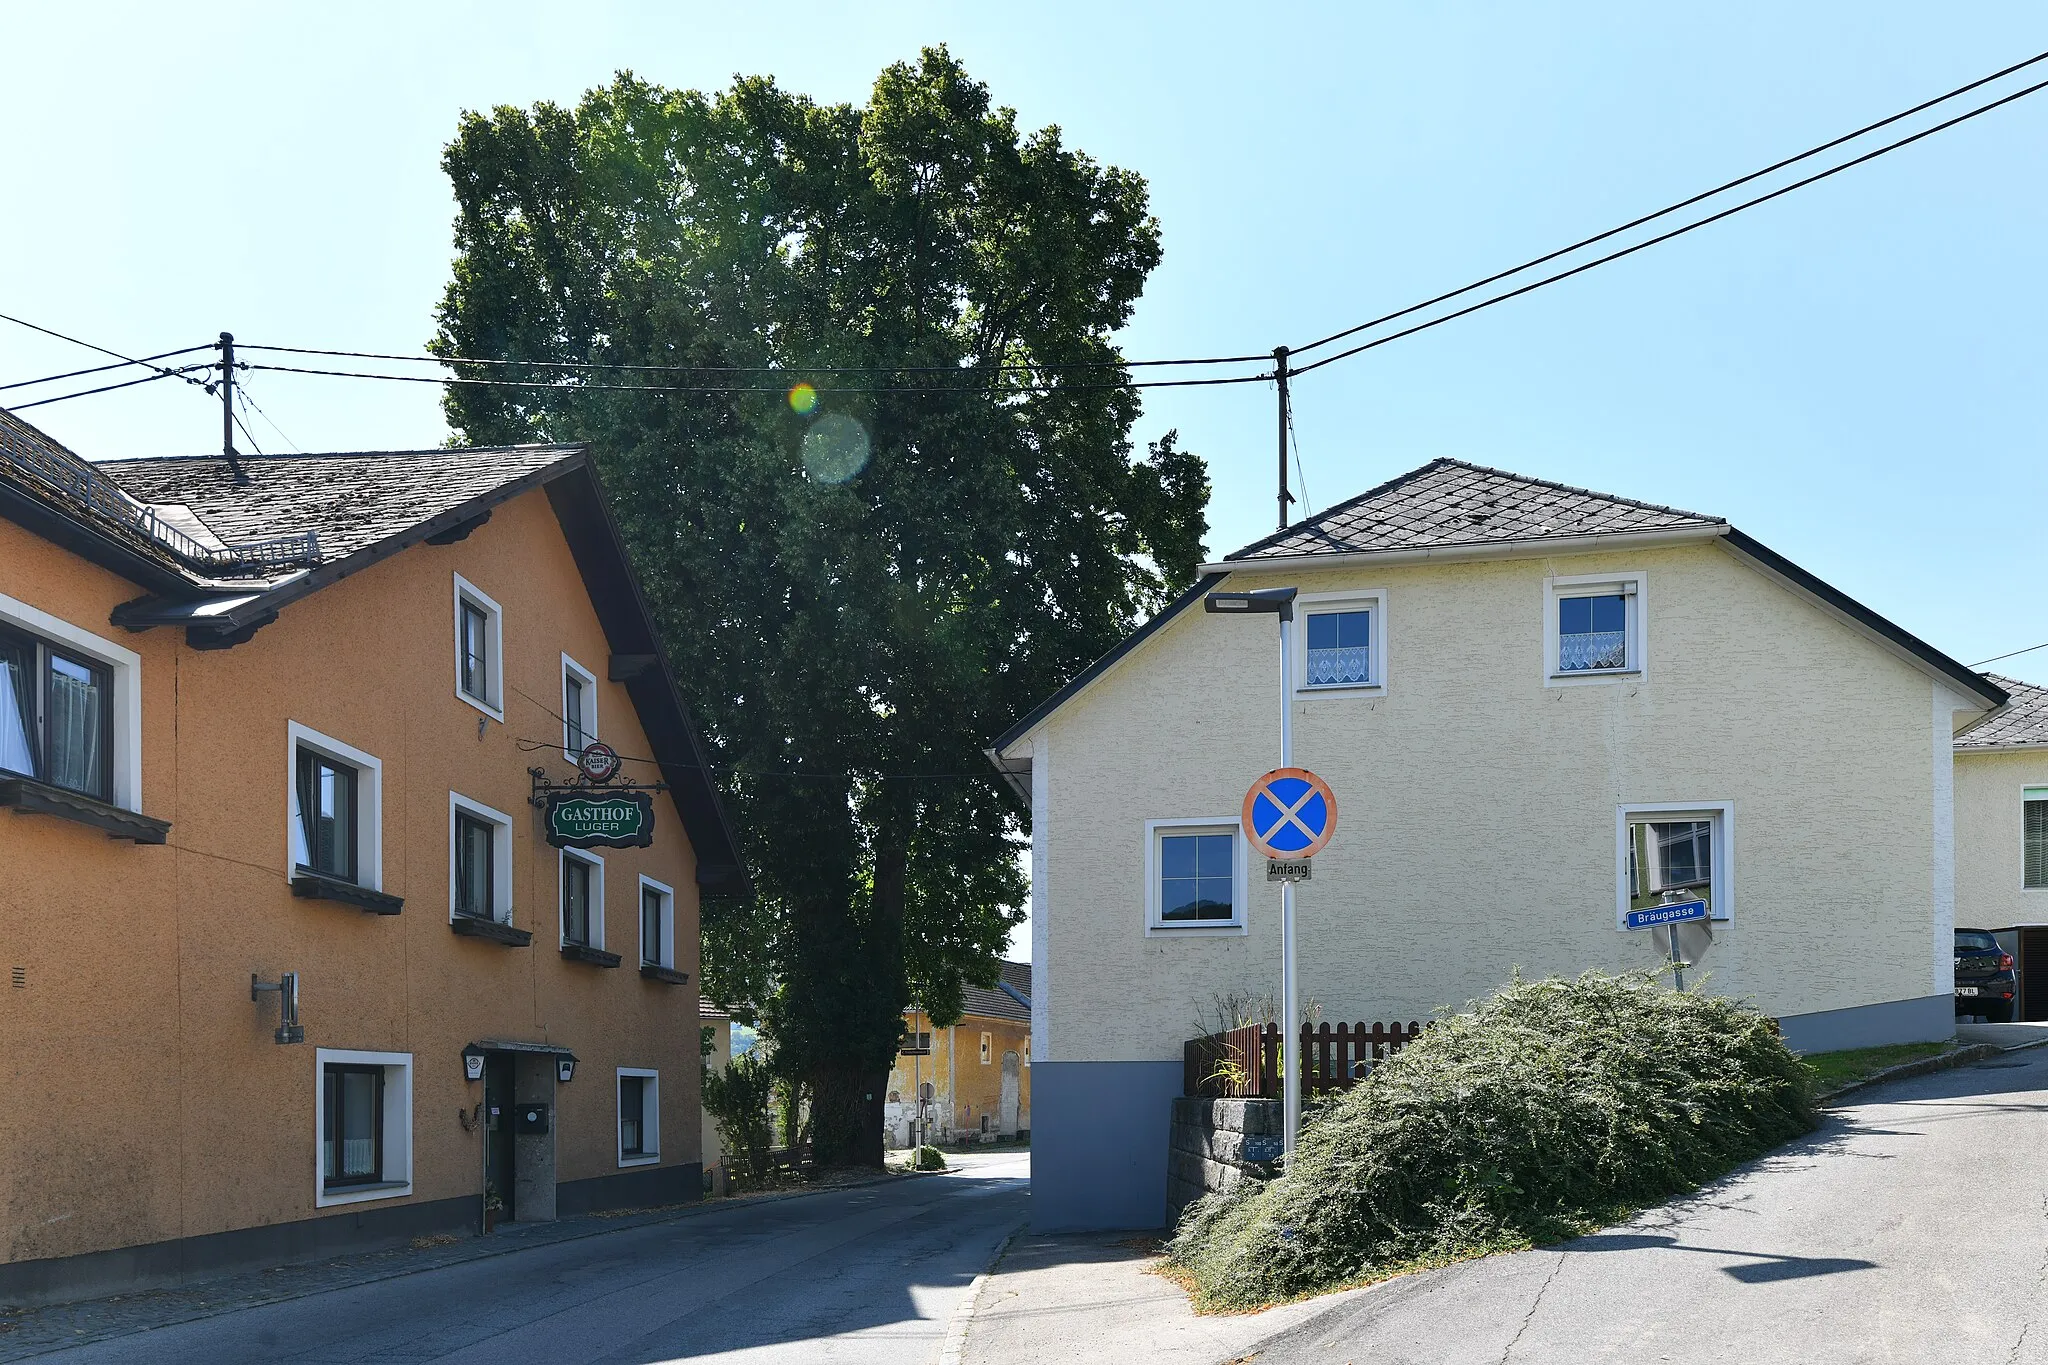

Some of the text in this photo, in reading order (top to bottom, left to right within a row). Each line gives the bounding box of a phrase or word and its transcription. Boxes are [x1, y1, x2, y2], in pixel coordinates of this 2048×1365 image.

[585, 757, 609, 766] KAISER
[561, 807, 634, 821] GASTHOF
[575, 822, 619, 831] LUGER
[1269, 863, 1308, 878] Anfang
[1637, 907, 1694, 924] Bräugasse
